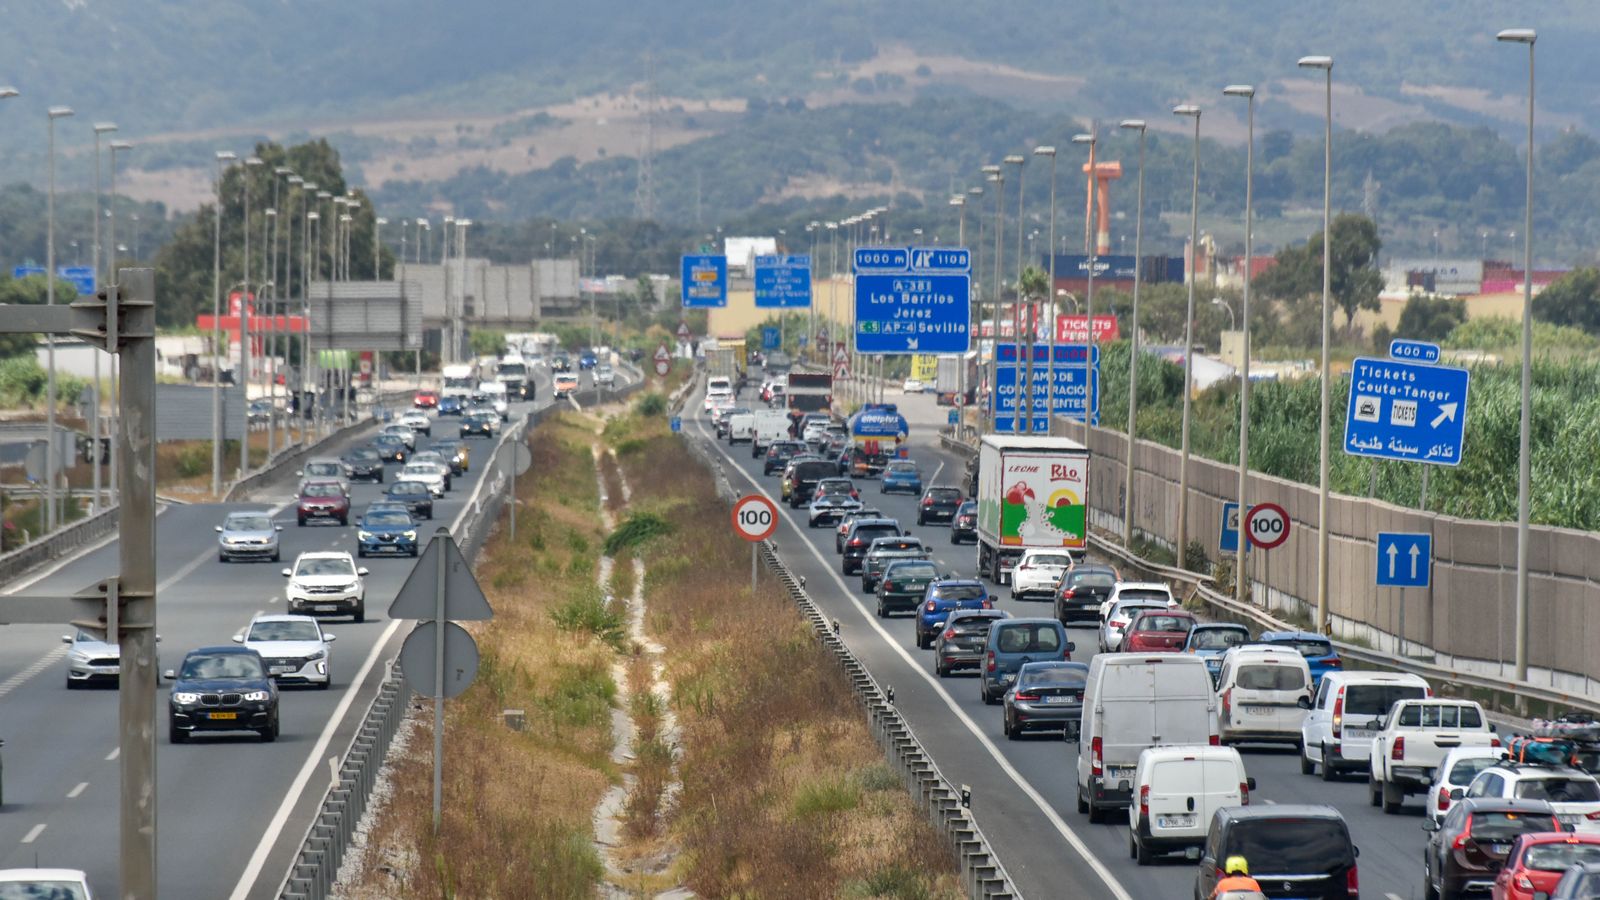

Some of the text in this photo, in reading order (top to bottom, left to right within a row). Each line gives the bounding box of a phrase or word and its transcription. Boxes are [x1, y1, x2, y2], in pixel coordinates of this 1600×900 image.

[859, 254, 889, 263] 1000
[939, 254, 966, 264] 110B
[895, 281, 931, 291] A-381
[871, 293, 954, 304] Los Barrios
[893, 307, 932, 319] Jerez
[860, 322, 878, 332] E-5
[884, 322, 914, 332] AP-4
[918, 322, 966, 333] Sevilla
[1394, 345, 1435, 358] 400 m
[1059, 372, 1073, 382] DE
[1360, 366, 1416, 382] Tickets
[1357, 381, 1450, 402] Ceuta-Tanger
[1003, 398, 1016, 408] DE
[1393, 405, 1416, 422] TICKETS
[1350, 433, 1453, 459] تذاكر سبتة طنجة
[1008, 465, 1041, 473] LECHE
[739, 510, 771, 526] 100
[1252, 518, 1283, 533] 100
